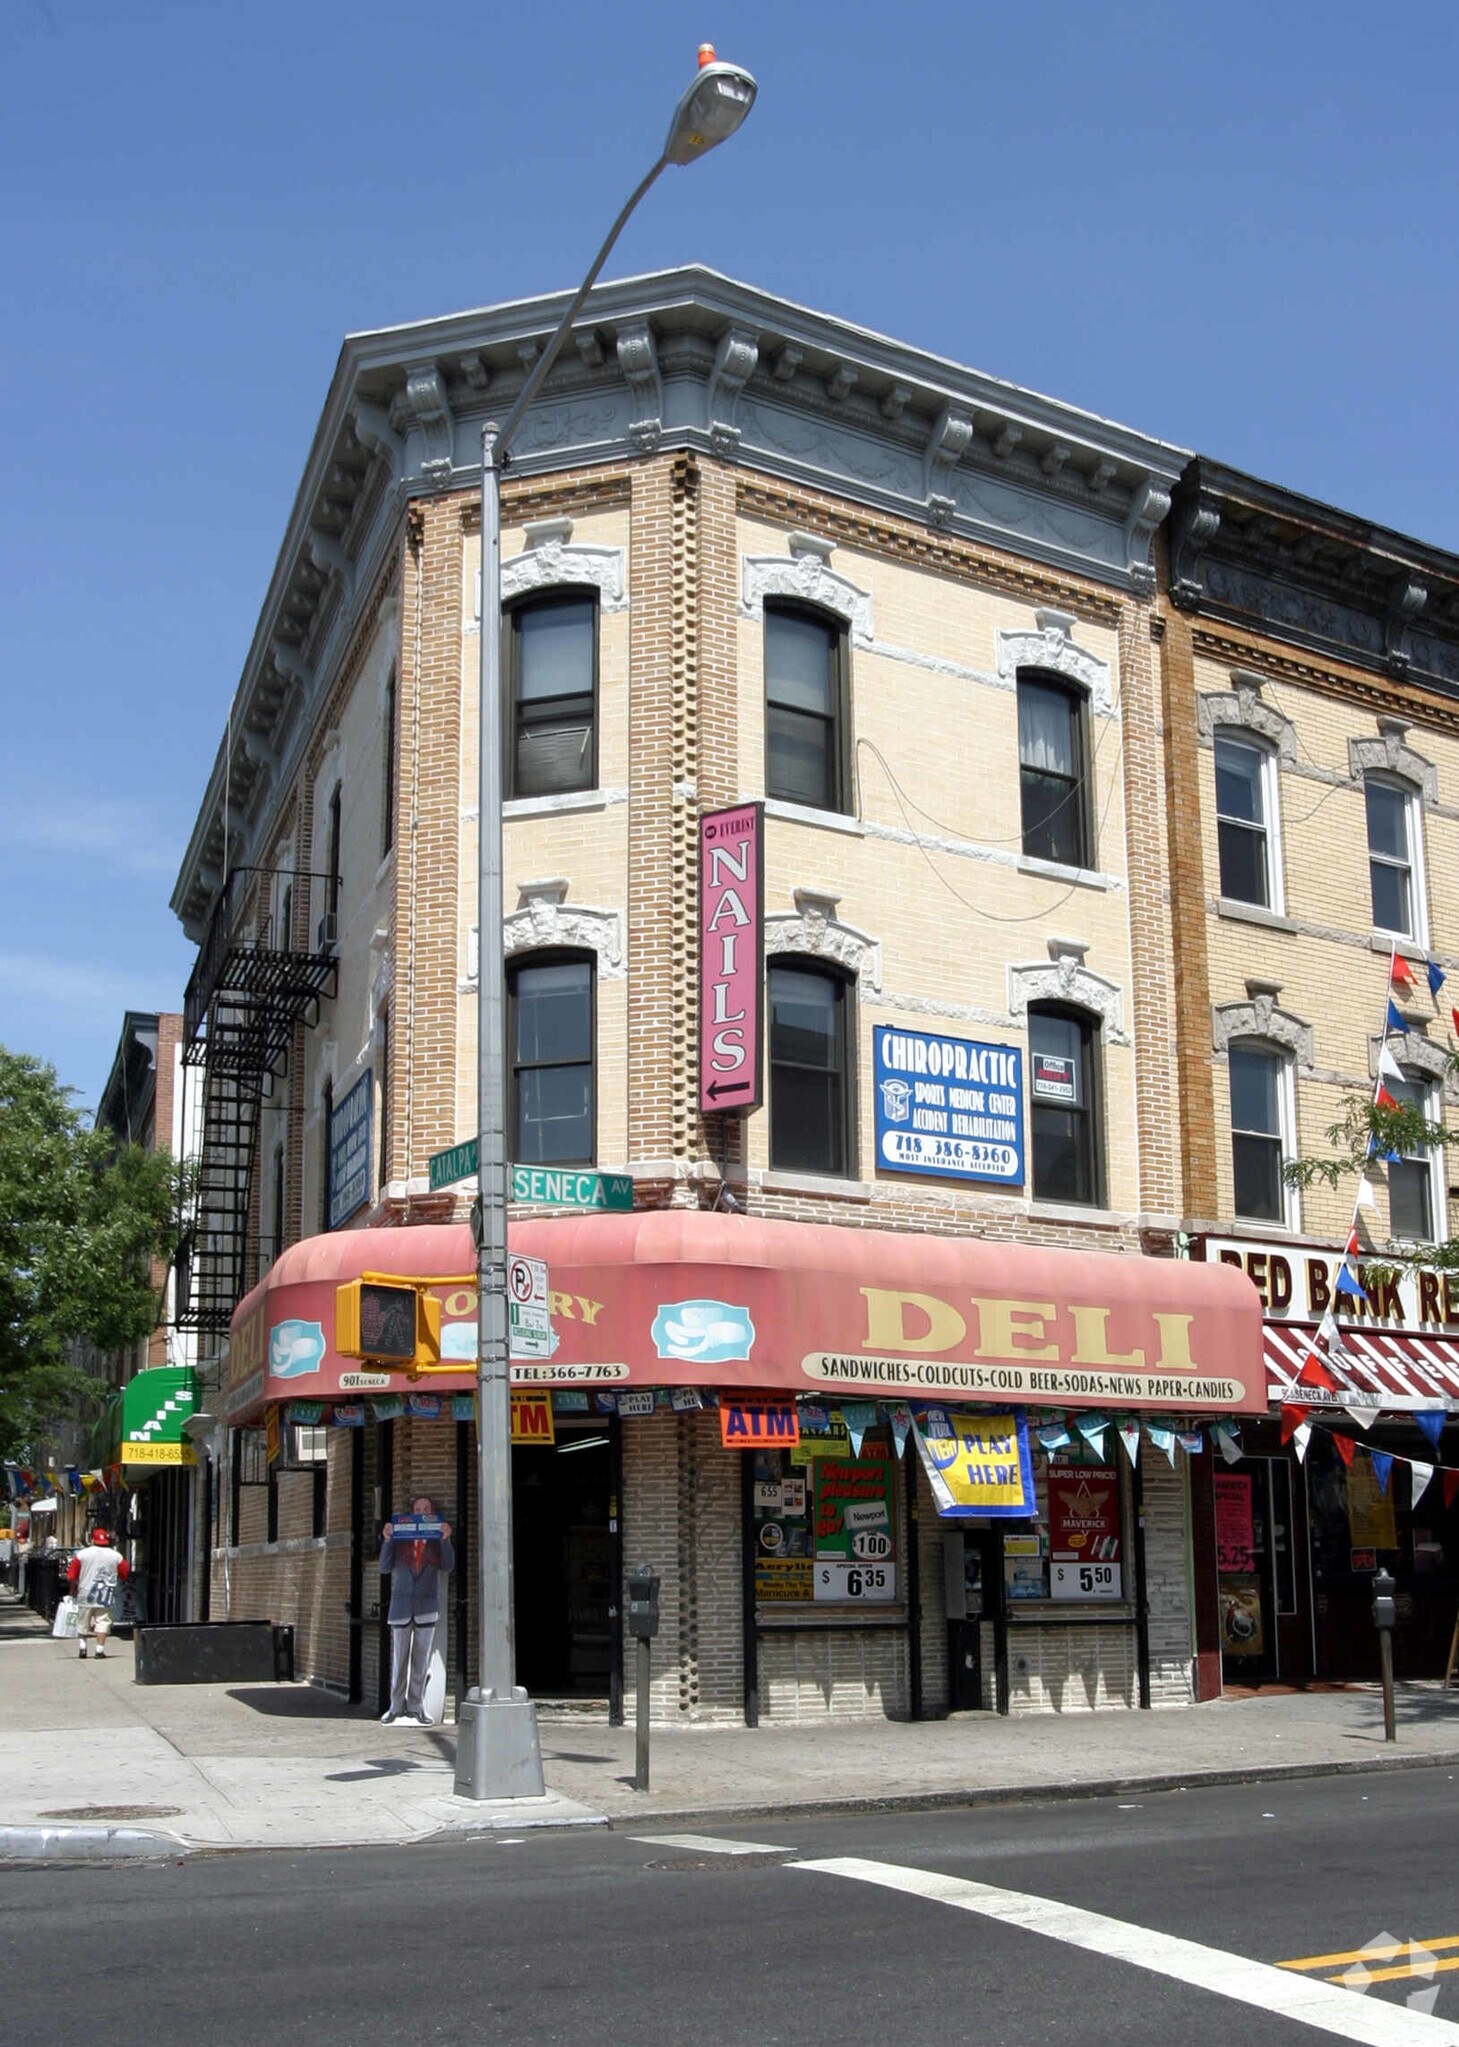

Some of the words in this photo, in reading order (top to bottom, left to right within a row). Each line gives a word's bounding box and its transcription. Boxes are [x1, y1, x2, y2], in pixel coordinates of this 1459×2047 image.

[708, 840, 751, 1072] NAILS
[882, 1033, 1016, 1088] CHIROPRACTIC
[914, 1082, 945, 1106] SPORTS
[949, 1087, 984, 1112] MEDICINE
[988, 1093, 1016, 1116] CENTER
[912, 1108, 948, 1133] ACCIDENT
[951, 1114, 1016, 1142] REHABILITATION
[895, 1134, 923, 1153] 718
[934, 1140, 1011, 1165] 386-8360
[898, 1153, 920, 1162] MOST
[923, 1156, 966, 1168] INSURANCE
[430, 1148, 471, 1187] CATALPA
[515, 1171, 607, 1205] SENECA
[611, 1179, 630, 1194] AV
[859, 1287, 1198, 1370] DELI
[343, 1375, 359, 1387] 901
[129, 1390, 194, 1441] NAILS
[726, 1406, 795, 1436] ATM
[963, 1434, 1012, 1454] PLAY
[967, 1463, 1018, 1485] HERE
[1049, 1470, 1074, 1479] SUPER
[1075, 1470, 1092, 1479] LOW
[853, 1509, 885, 1521] Newport
[1062, 1519, 1107, 1529] MAVERICK
